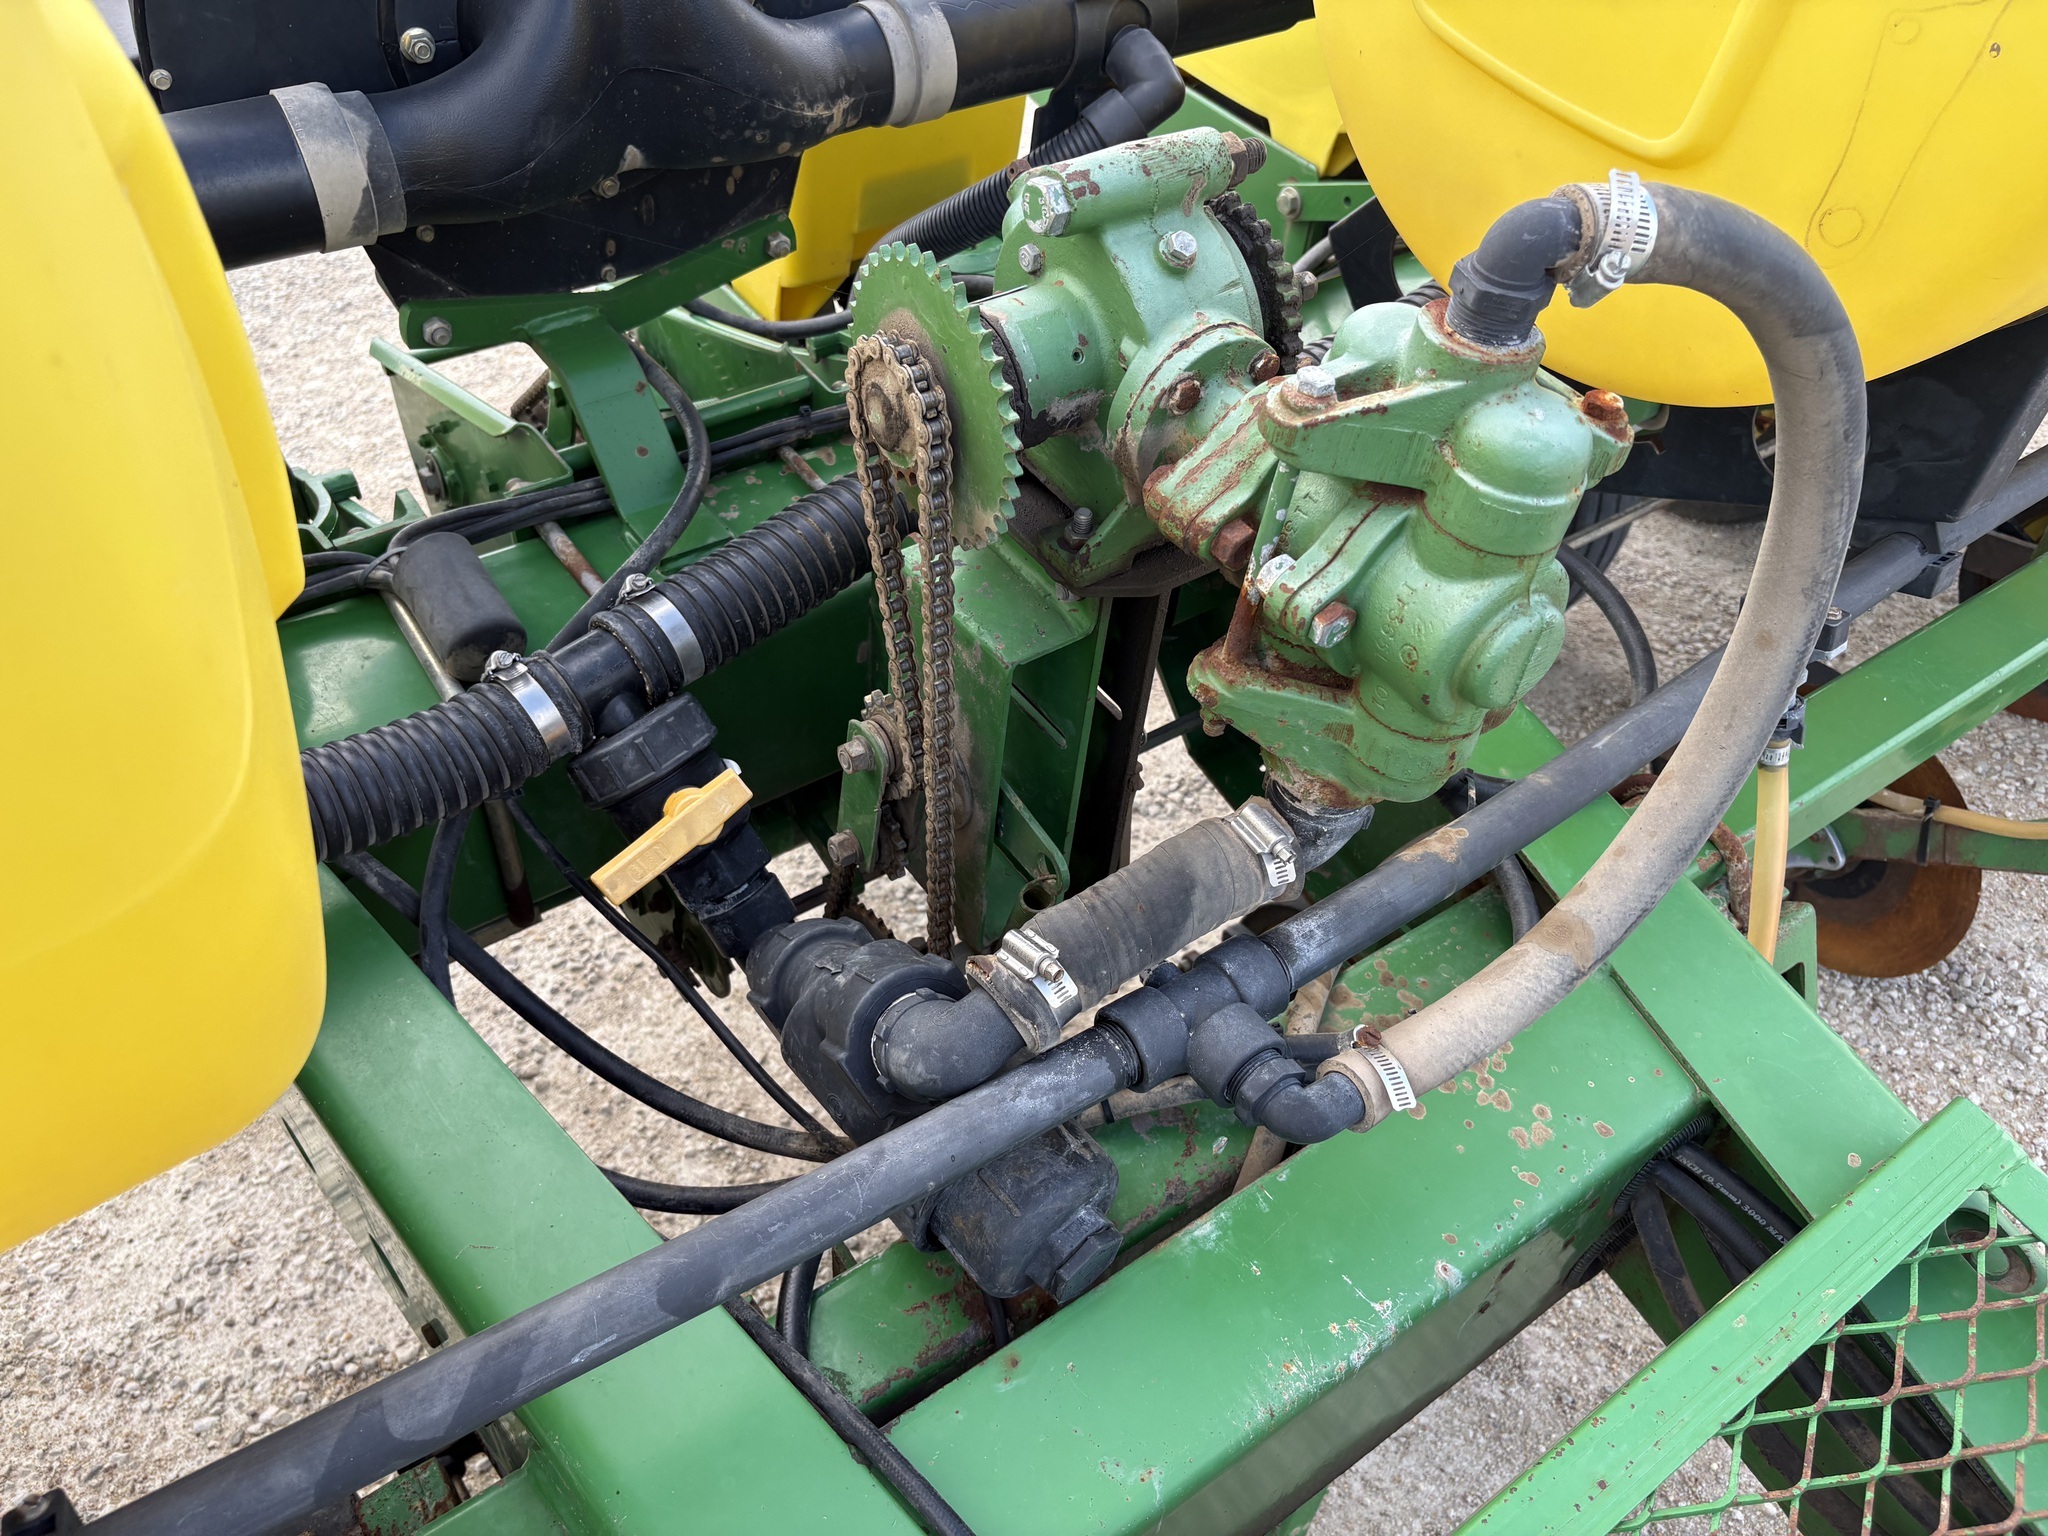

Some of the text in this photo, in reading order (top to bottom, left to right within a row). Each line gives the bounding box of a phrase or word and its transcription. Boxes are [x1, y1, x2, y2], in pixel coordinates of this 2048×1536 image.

[1675, 1154, 1703, 1175] INCH
[1701, 1173, 1742, 1205] (9.5mm)
[1740, 1203, 1767, 1226] 3000
